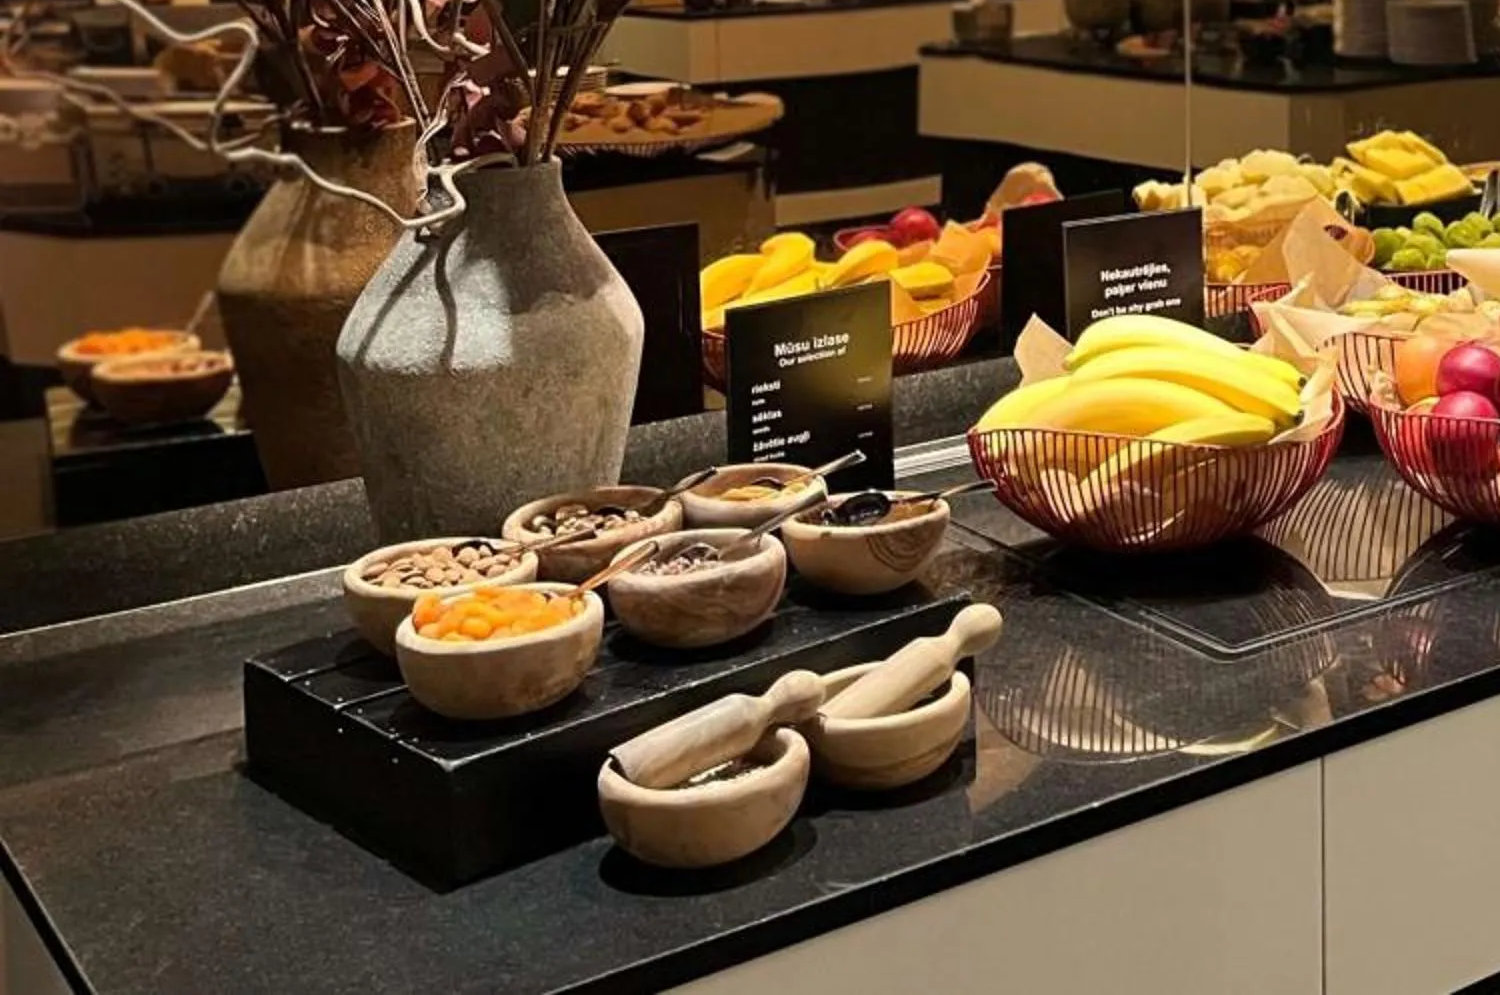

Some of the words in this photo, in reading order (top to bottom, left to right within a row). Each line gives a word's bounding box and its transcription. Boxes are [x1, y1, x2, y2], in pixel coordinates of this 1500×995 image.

[1138, 279, 1168, 291] vienu
[813, 332, 850, 349] izlase
[778, 357, 796, 368] Our
